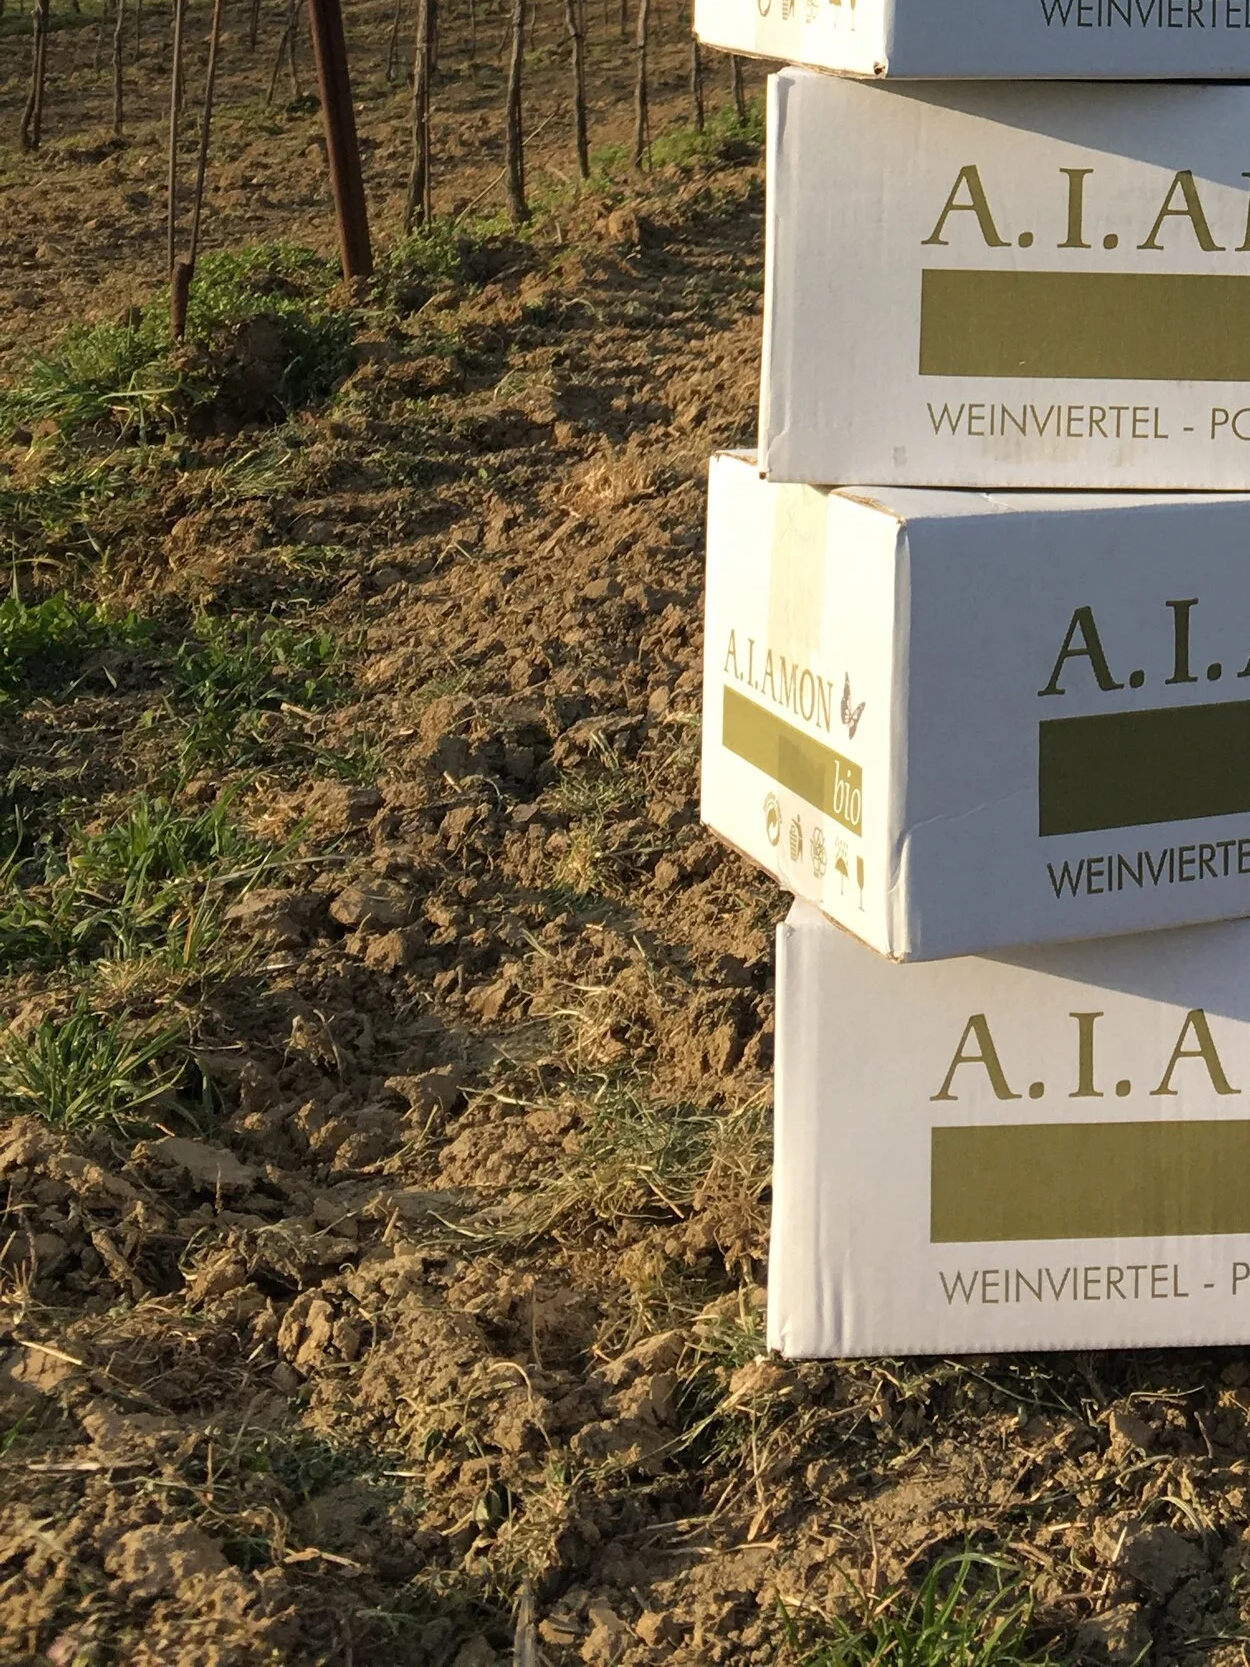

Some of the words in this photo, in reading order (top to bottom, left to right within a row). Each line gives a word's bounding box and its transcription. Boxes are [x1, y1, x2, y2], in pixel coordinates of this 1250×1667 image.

[927, 403, 1169, 440] WEINVIERTEL
[723, 628, 834, 732] A.I.AMON
[833, 759, 863, 826] bio
[939, 1264, 1189, 1305] WEINVIERTEL
